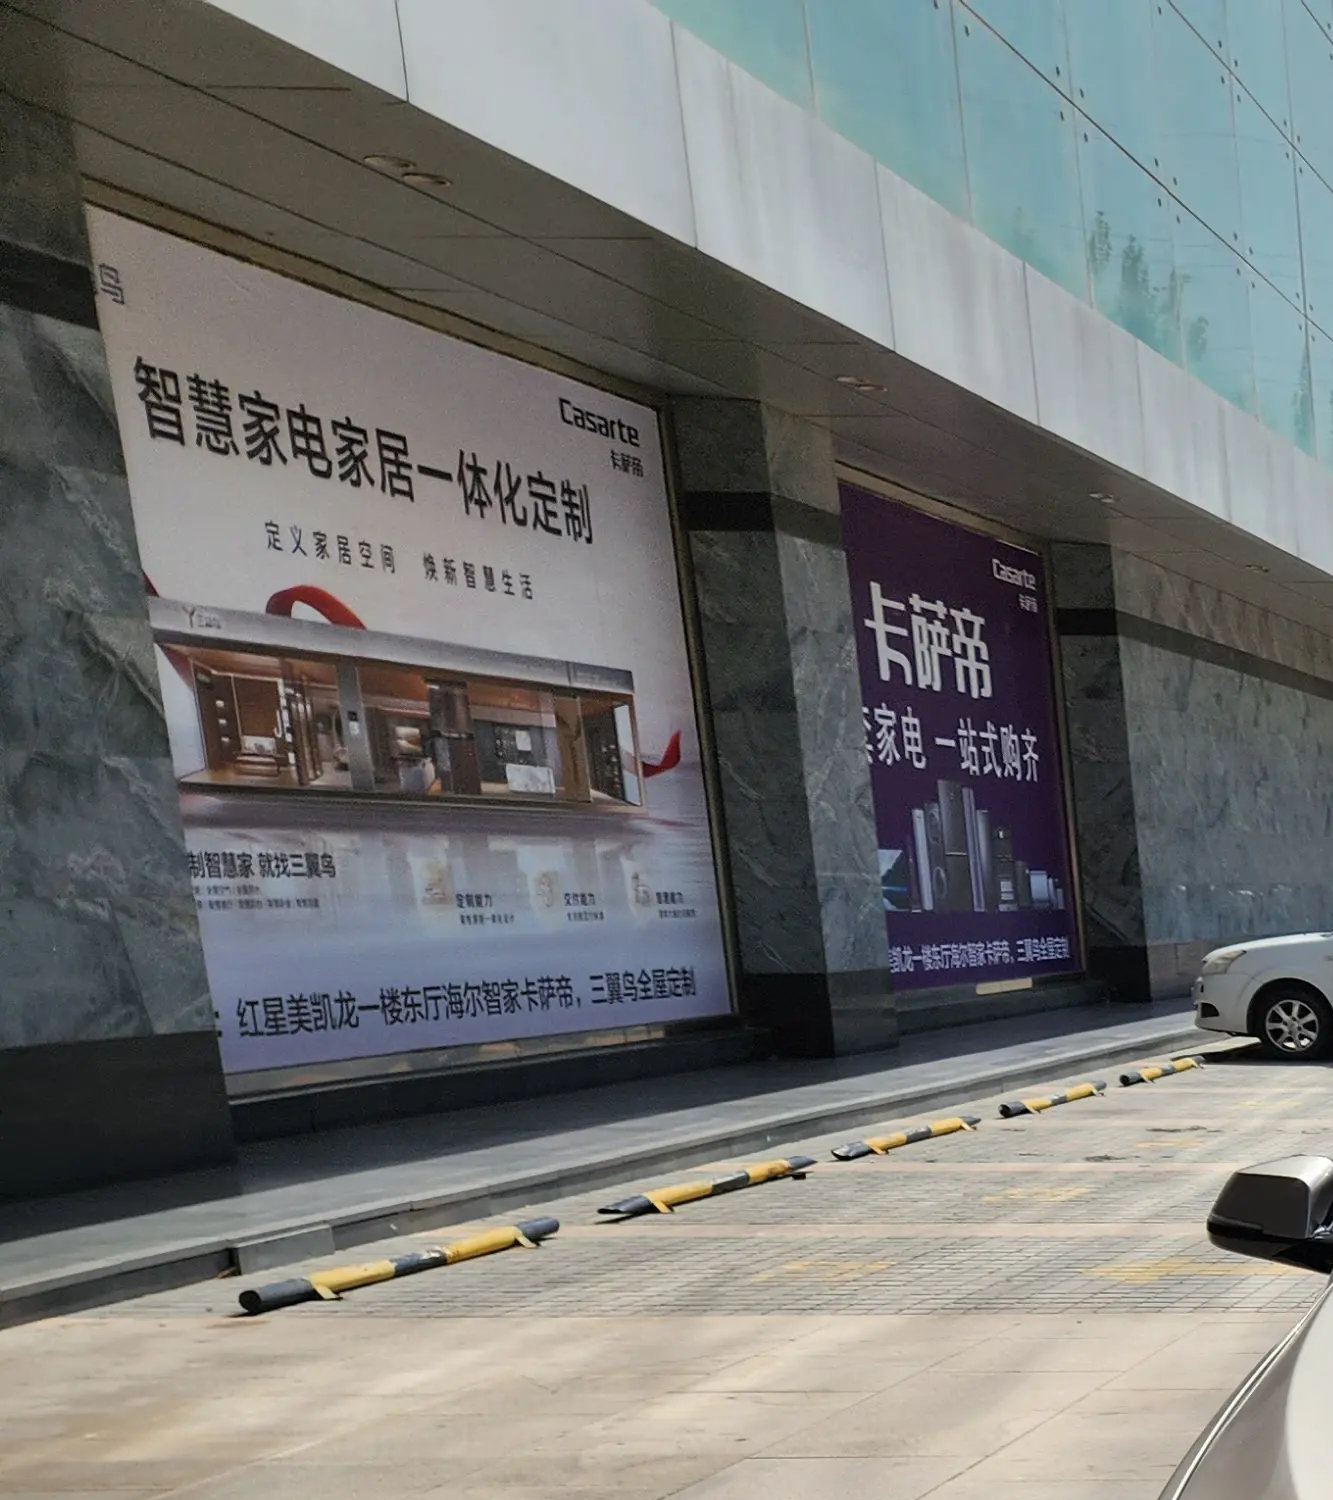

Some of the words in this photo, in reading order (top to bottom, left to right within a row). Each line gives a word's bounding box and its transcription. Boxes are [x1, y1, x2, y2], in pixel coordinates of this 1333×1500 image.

[133, 355, 594, 545] 智慧家电家居一体化定制
[558, 397, 641, 448] Casarte
[264, 519, 396, 575] 定义家居空间
[991, 558, 1037, 591] Casarte
[864, 580, 993, 699] 卡萨帝
[934, 716, 1040, 783] 一站式购齐
